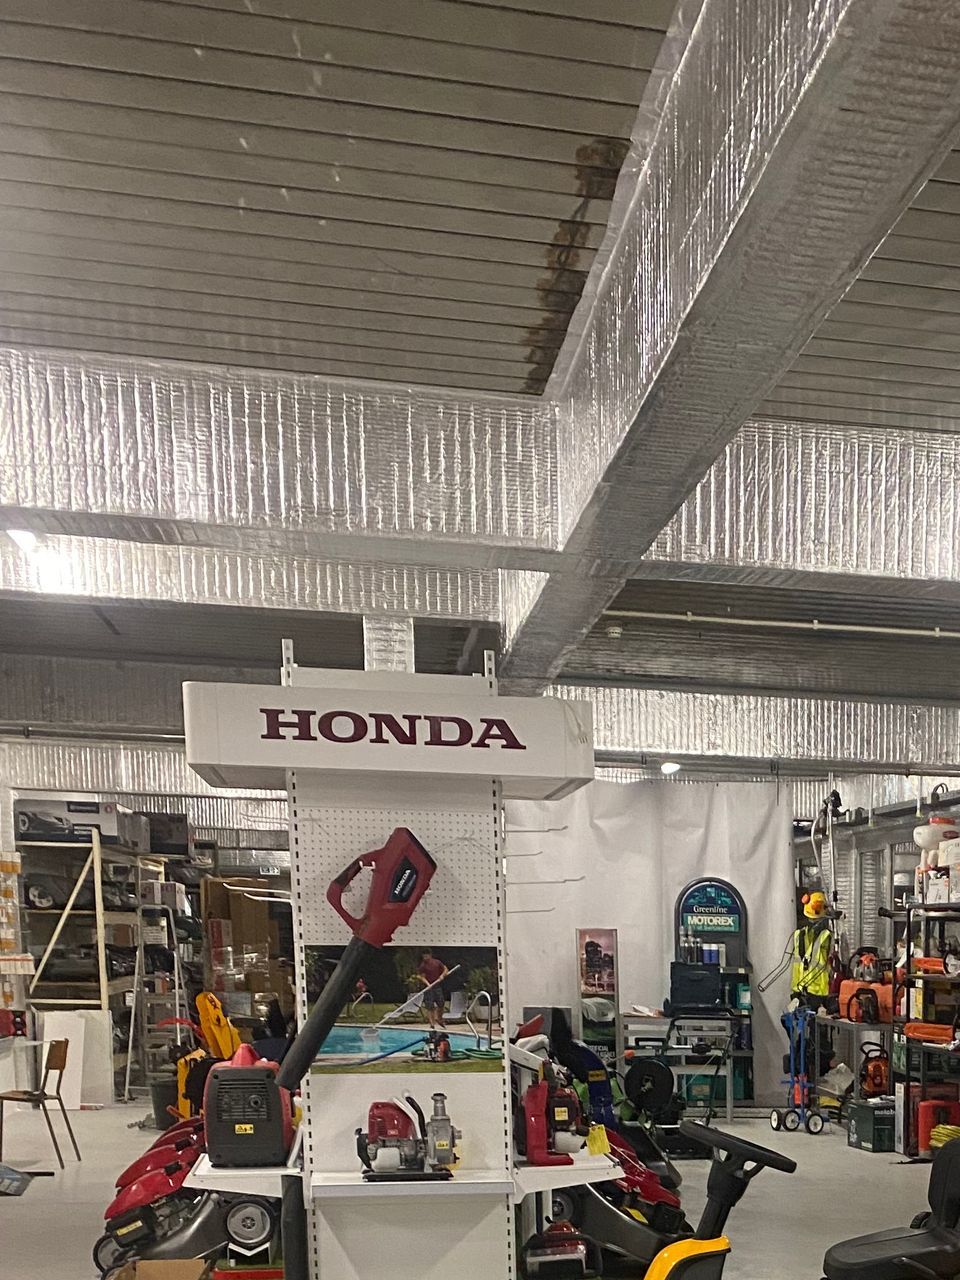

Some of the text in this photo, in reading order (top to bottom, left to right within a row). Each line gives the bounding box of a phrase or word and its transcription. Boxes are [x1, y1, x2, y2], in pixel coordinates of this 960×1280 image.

[259, 707, 527, 750] HONDA
[394, 869, 411, 895] HONDA
[693, 905, 728, 913] Greenline
[687, 915, 734, 926] MOTOREX
